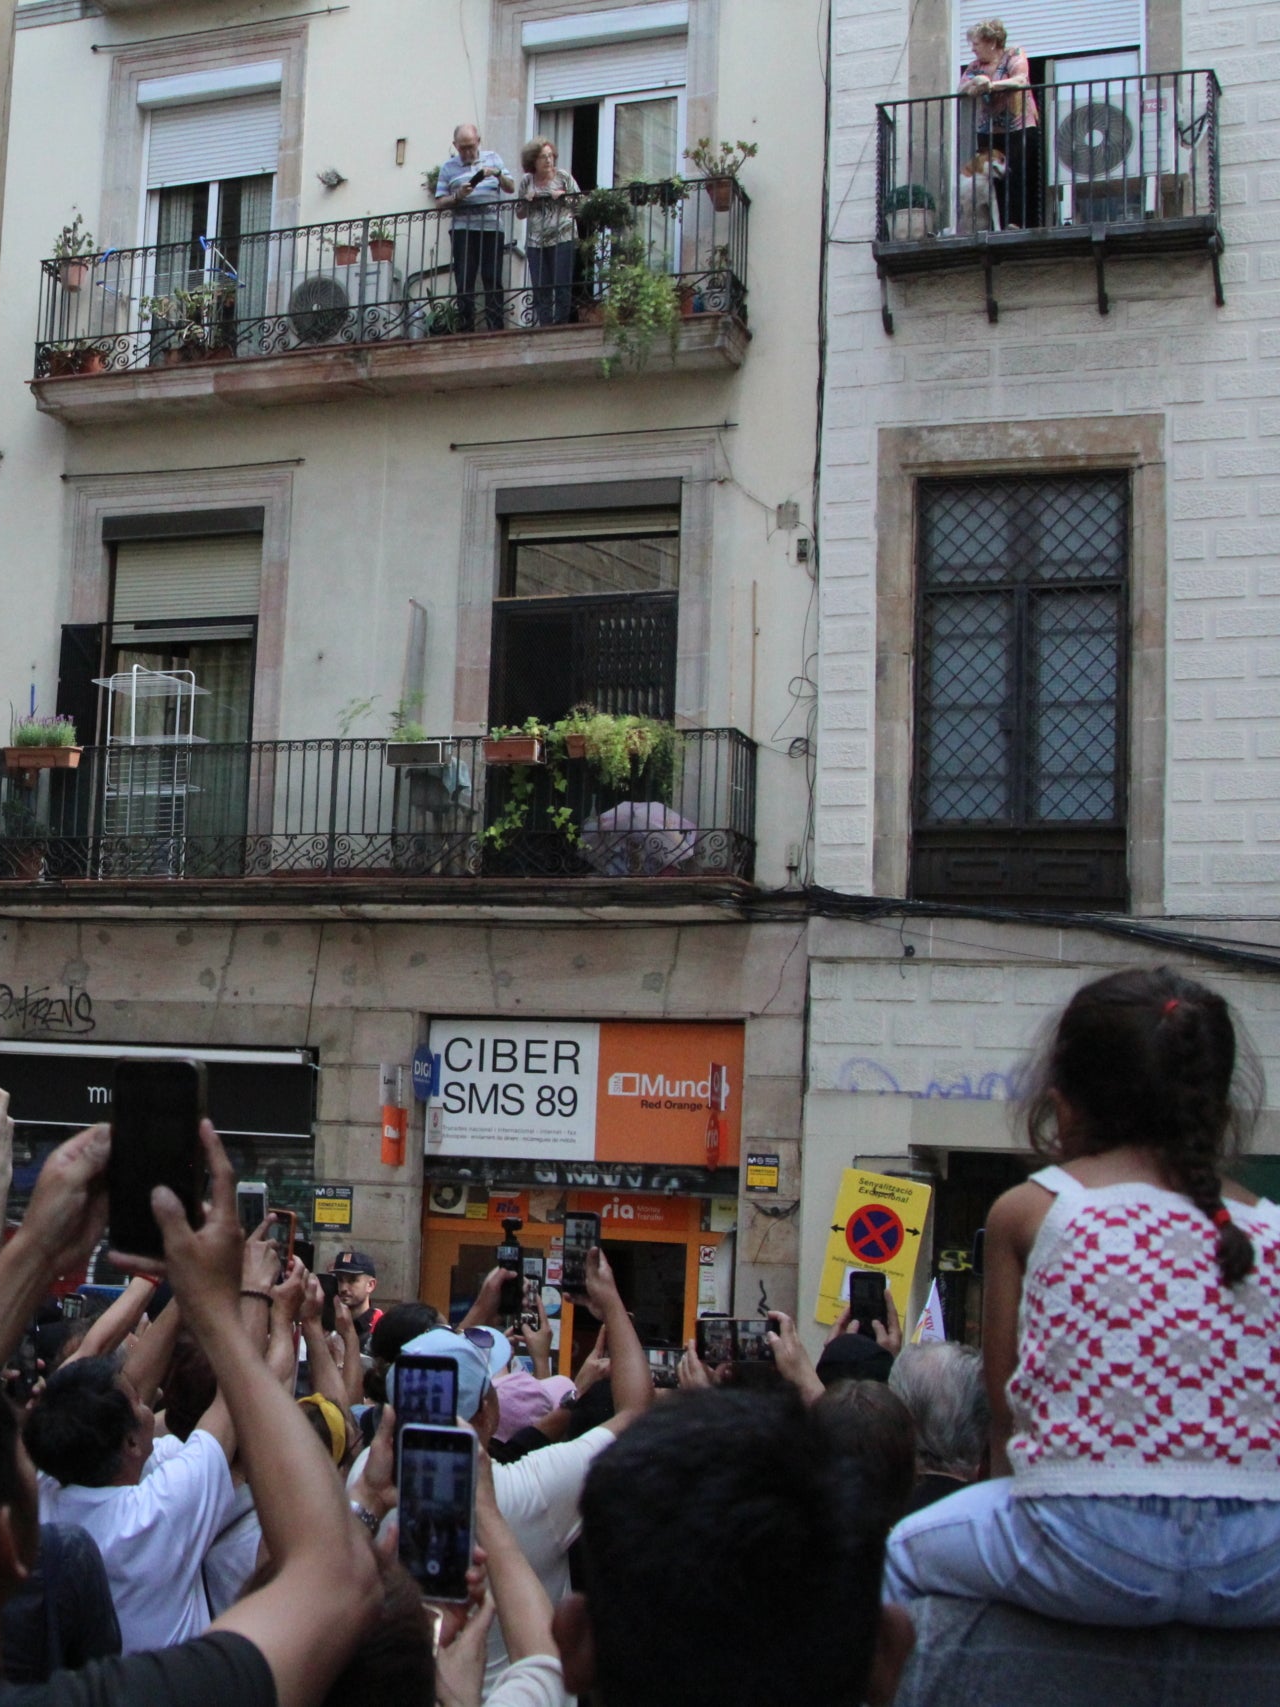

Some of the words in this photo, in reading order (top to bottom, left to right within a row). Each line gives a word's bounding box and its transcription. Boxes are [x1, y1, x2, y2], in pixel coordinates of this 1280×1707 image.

[444, 1037, 581, 1075] CIBER
[414, 1061, 431, 1078] DIGI
[442, 1081, 525, 1116] SMS
[535, 1085, 578, 1118] 89
[640, 1100, 662, 1109] Red
[664, 1100, 703, 1112] Orange
[858, 1177, 913, 1196] Senyalització
[496, 1202, 520, 1213] Ria
[602, 1197, 634, 1219] ria
